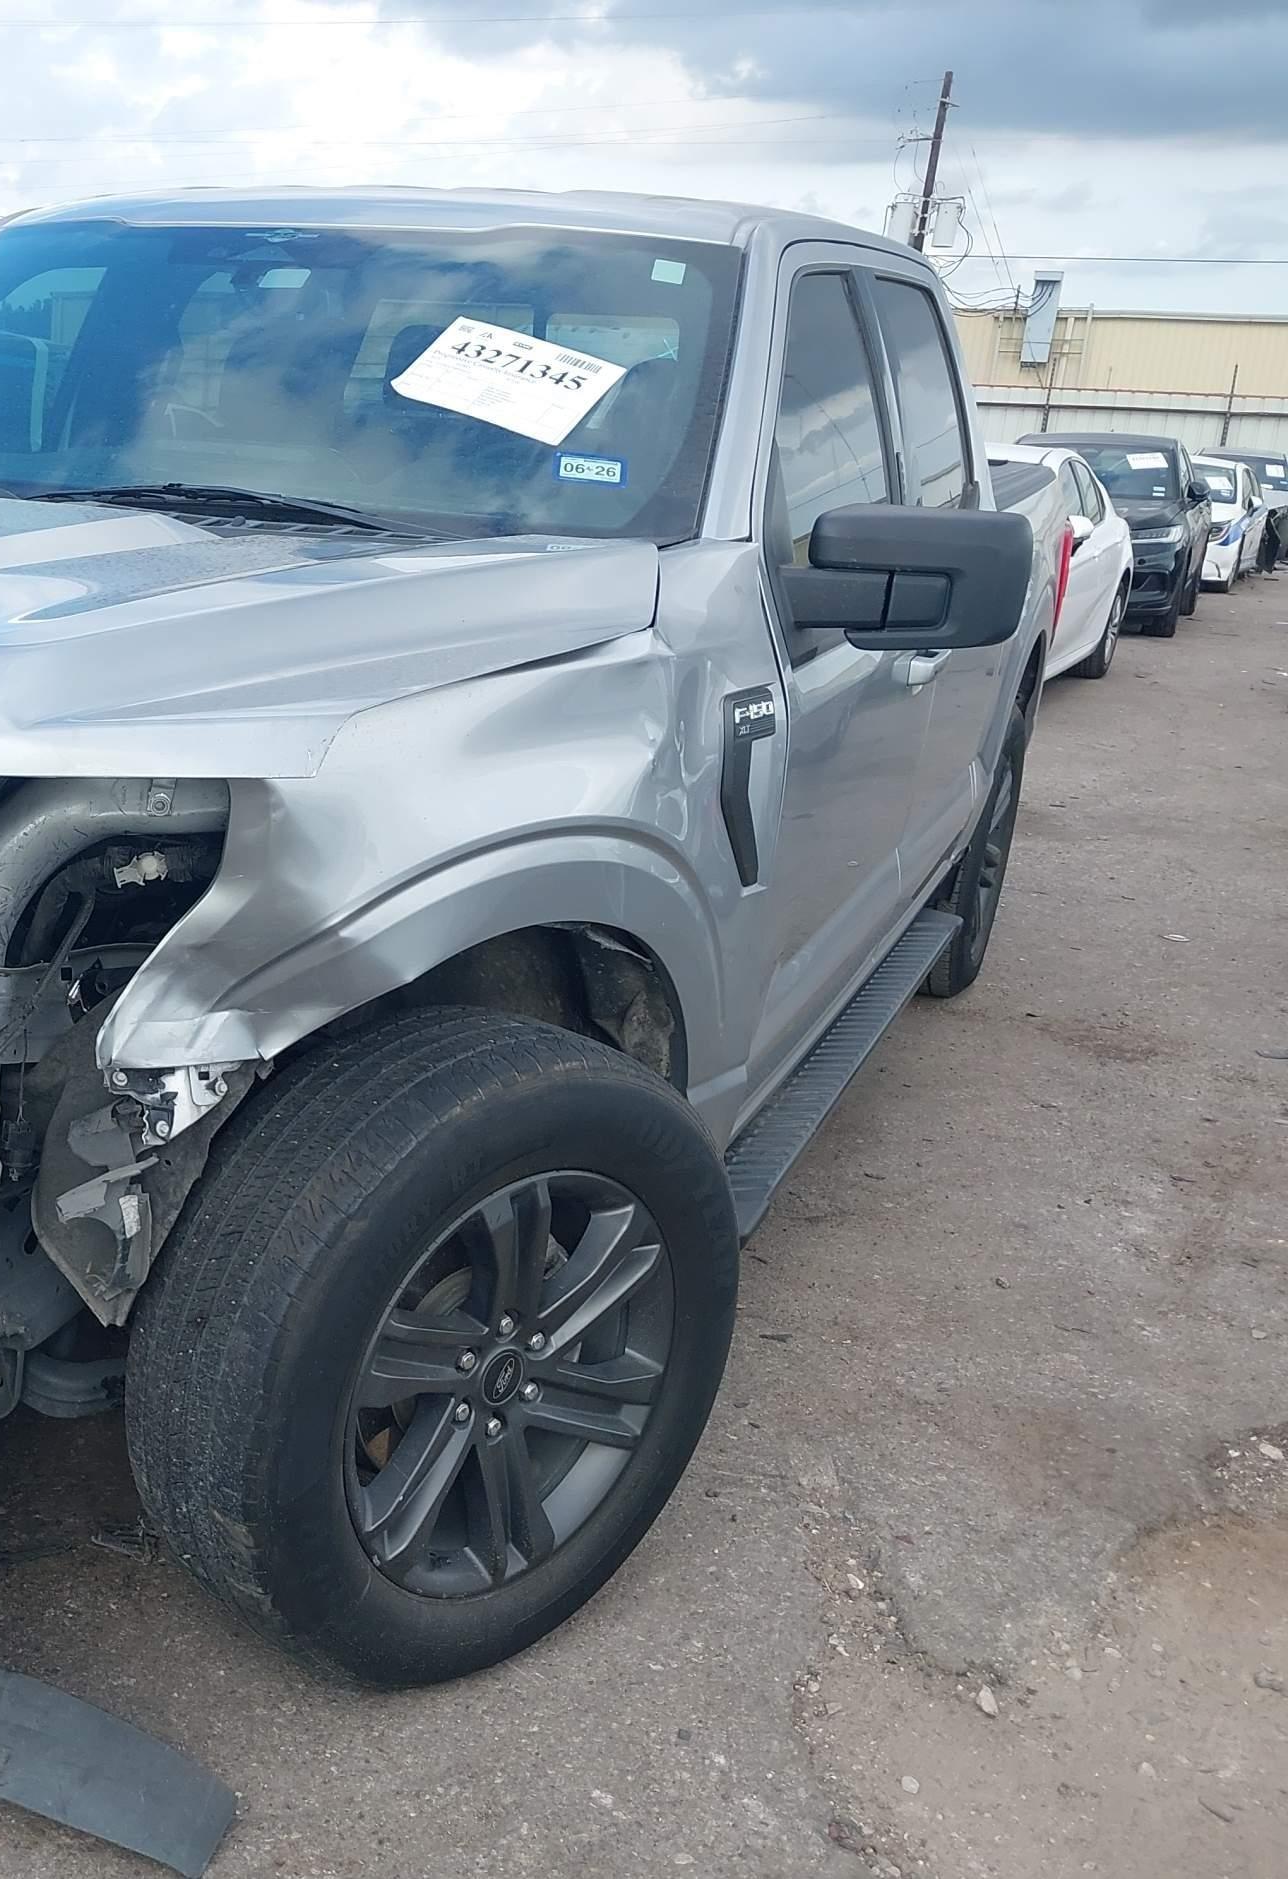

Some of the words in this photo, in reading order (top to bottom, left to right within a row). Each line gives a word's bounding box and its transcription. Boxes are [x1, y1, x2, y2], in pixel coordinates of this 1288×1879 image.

[451, 341, 588, 391] 43271345
[564, 462, 585, 474] 06
[595, 465, 617, 478] 26
[735, 701, 774, 724] F-150
